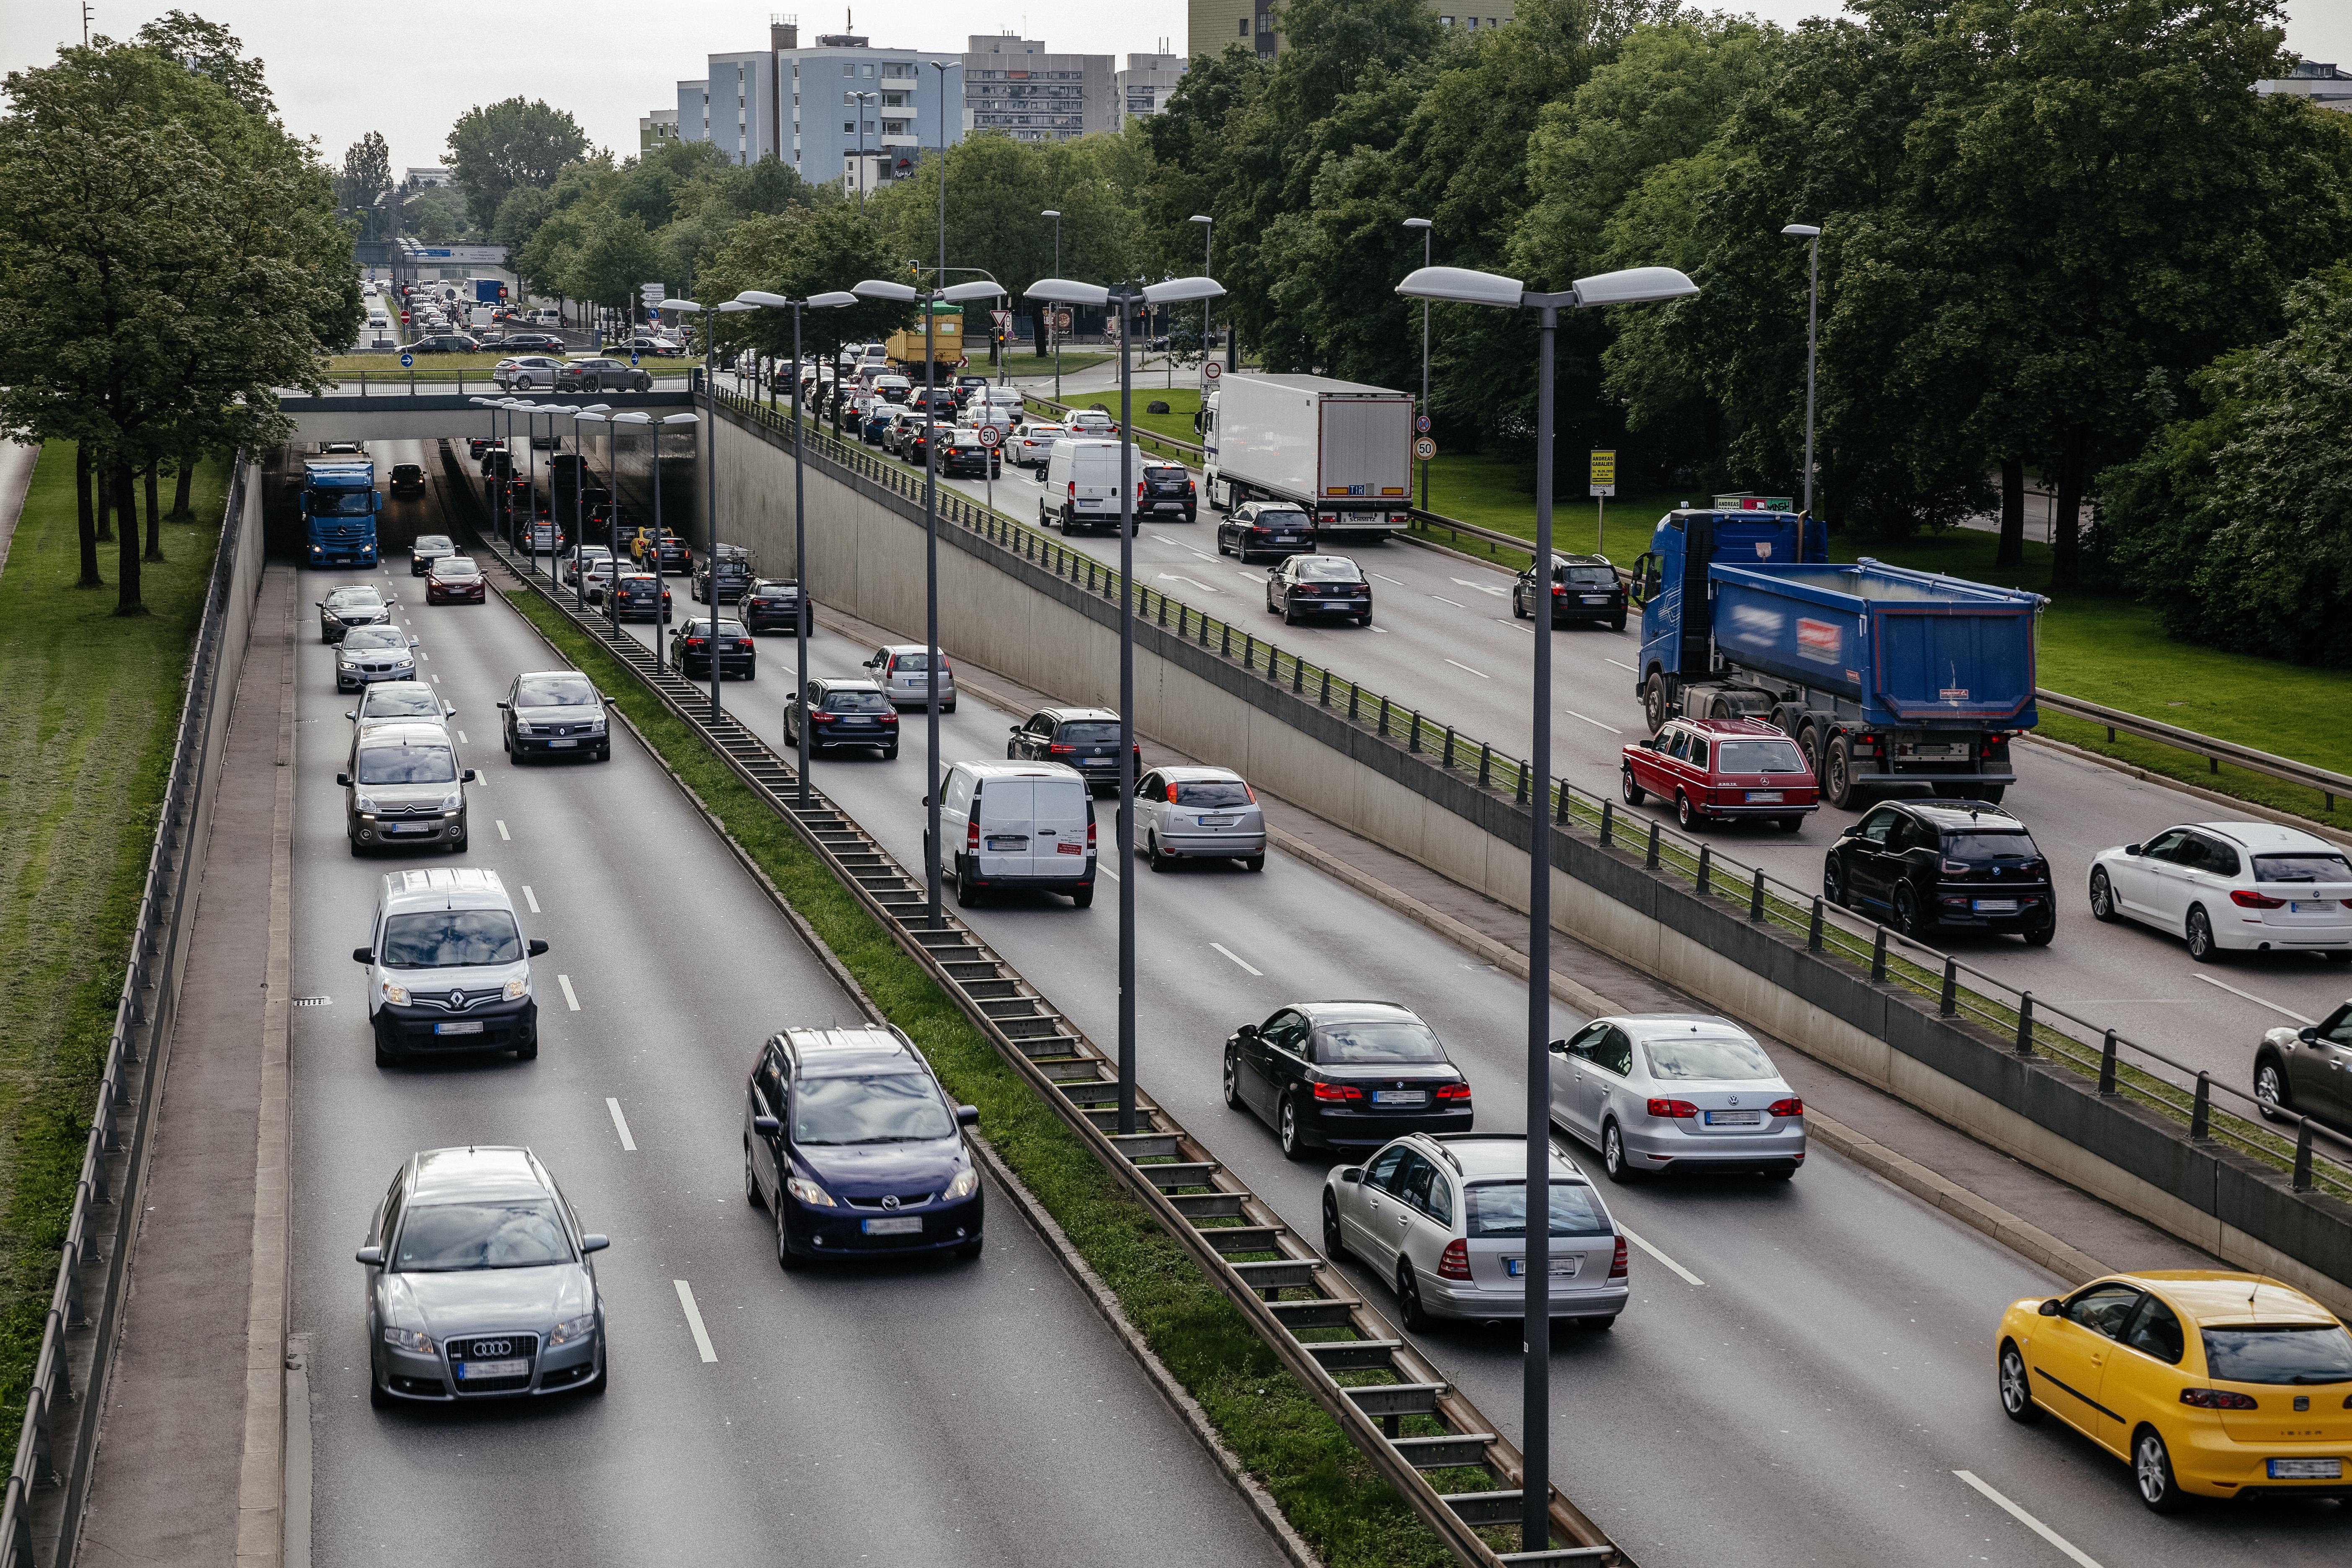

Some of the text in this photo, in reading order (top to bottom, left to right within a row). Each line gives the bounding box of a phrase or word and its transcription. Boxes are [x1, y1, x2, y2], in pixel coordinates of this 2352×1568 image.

[983, 431, 995, 441] 50
[1419, 444, 1431, 454] 50
[1350, 486, 1364, 494] TIR
